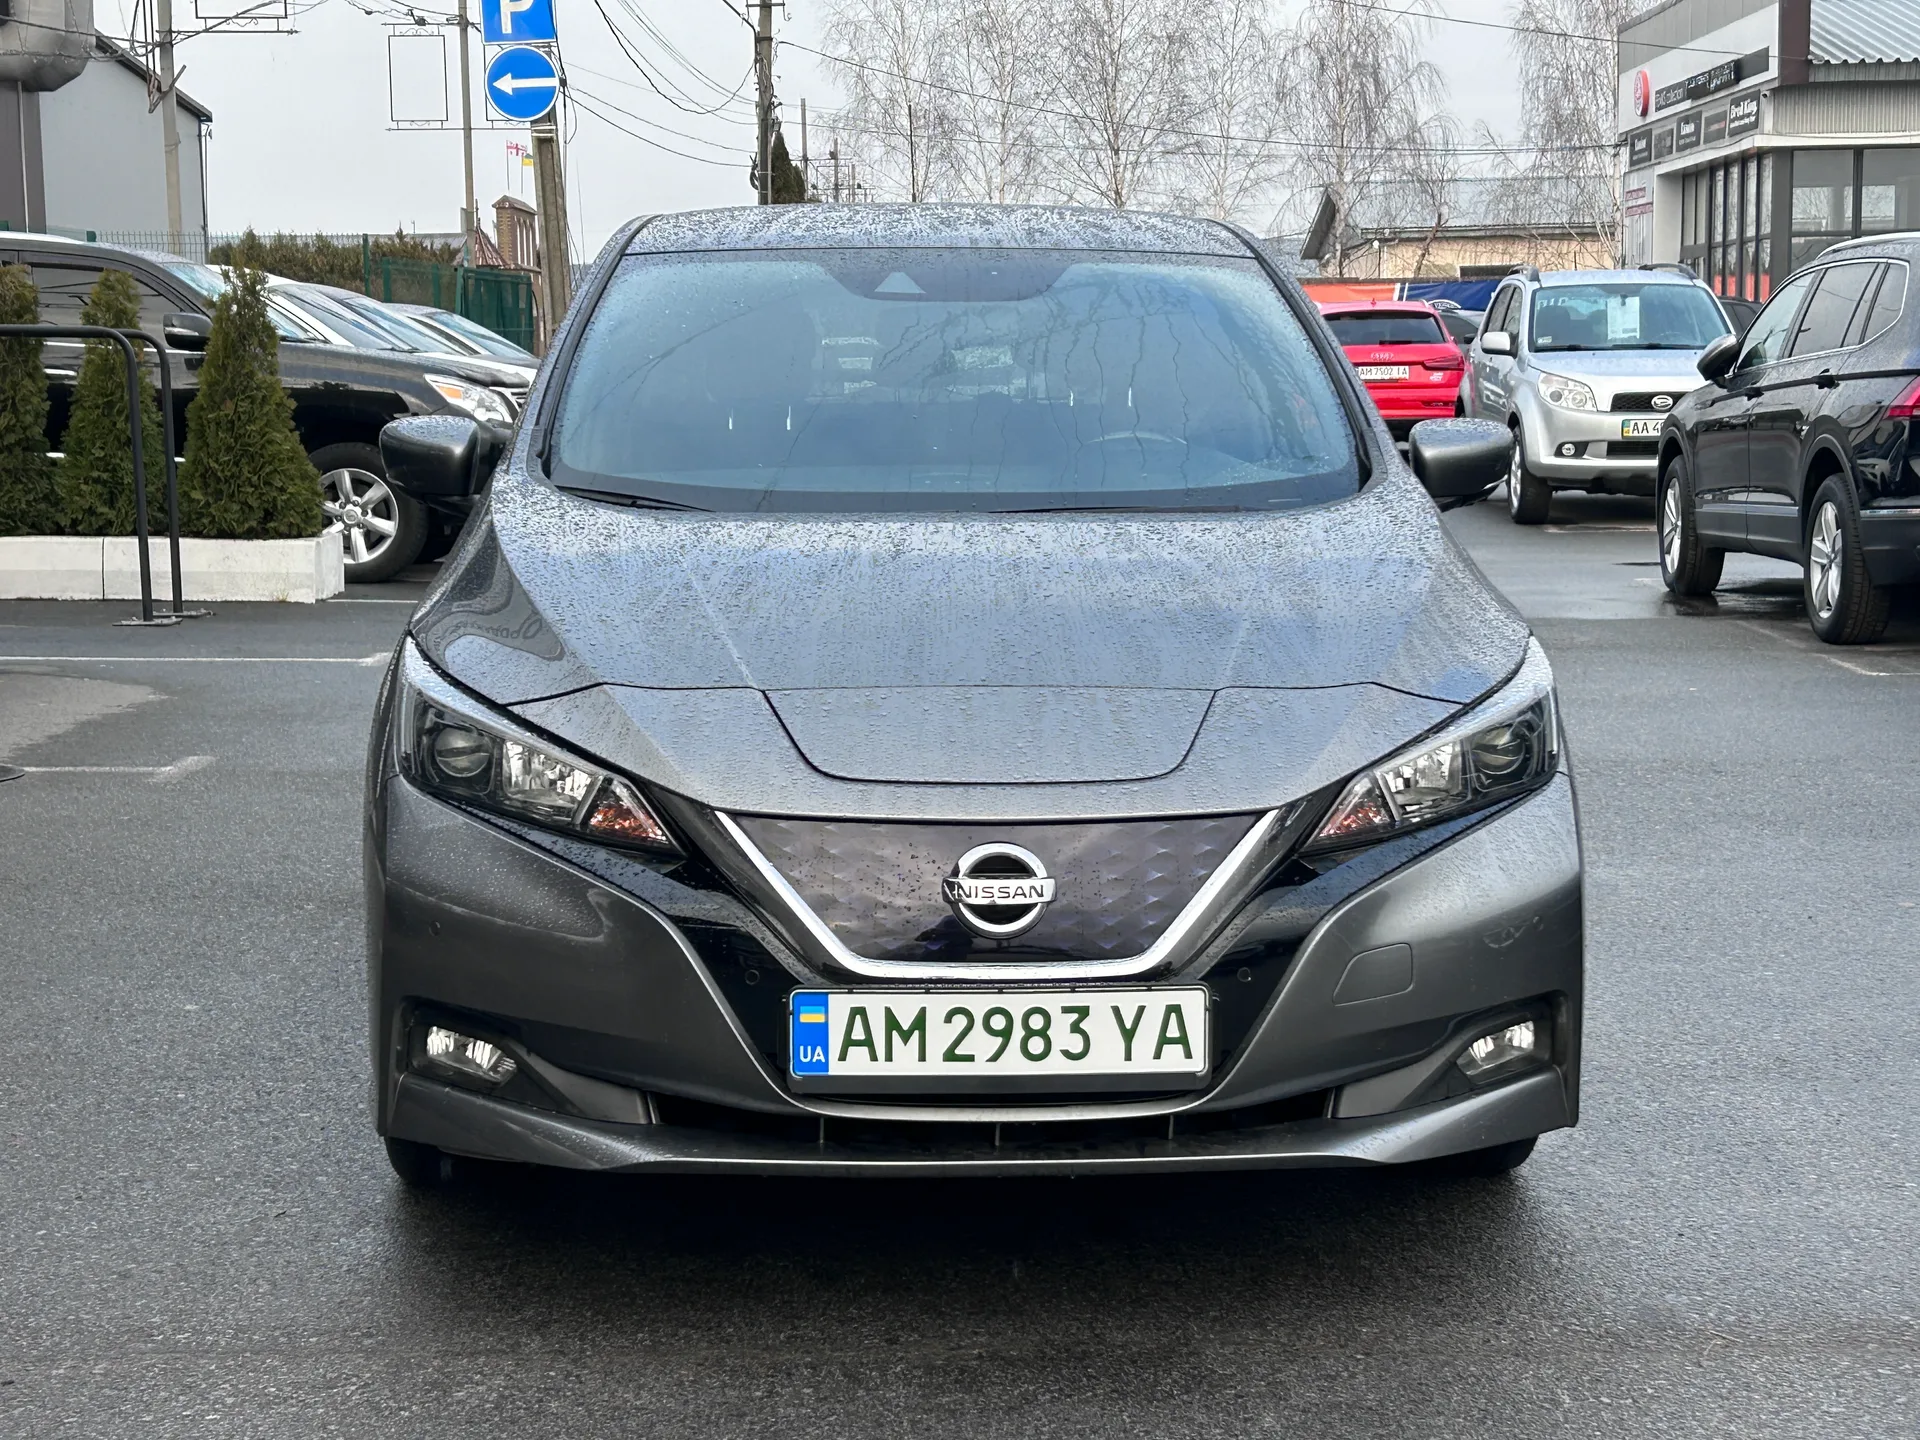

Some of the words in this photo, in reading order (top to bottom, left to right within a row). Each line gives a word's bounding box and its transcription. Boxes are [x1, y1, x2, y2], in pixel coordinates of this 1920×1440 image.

[500, 0, 535, 34] P
[1632, 421, 1649, 434] AA
[954, 884, 1045, 900] NISSAN
[837, 1006, 927, 1063] AM
[942, 1005, 1091, 1063] 2983
[1110, 1004, 1193, 1062] YA
[799, 1045, 826, 1063] UA
